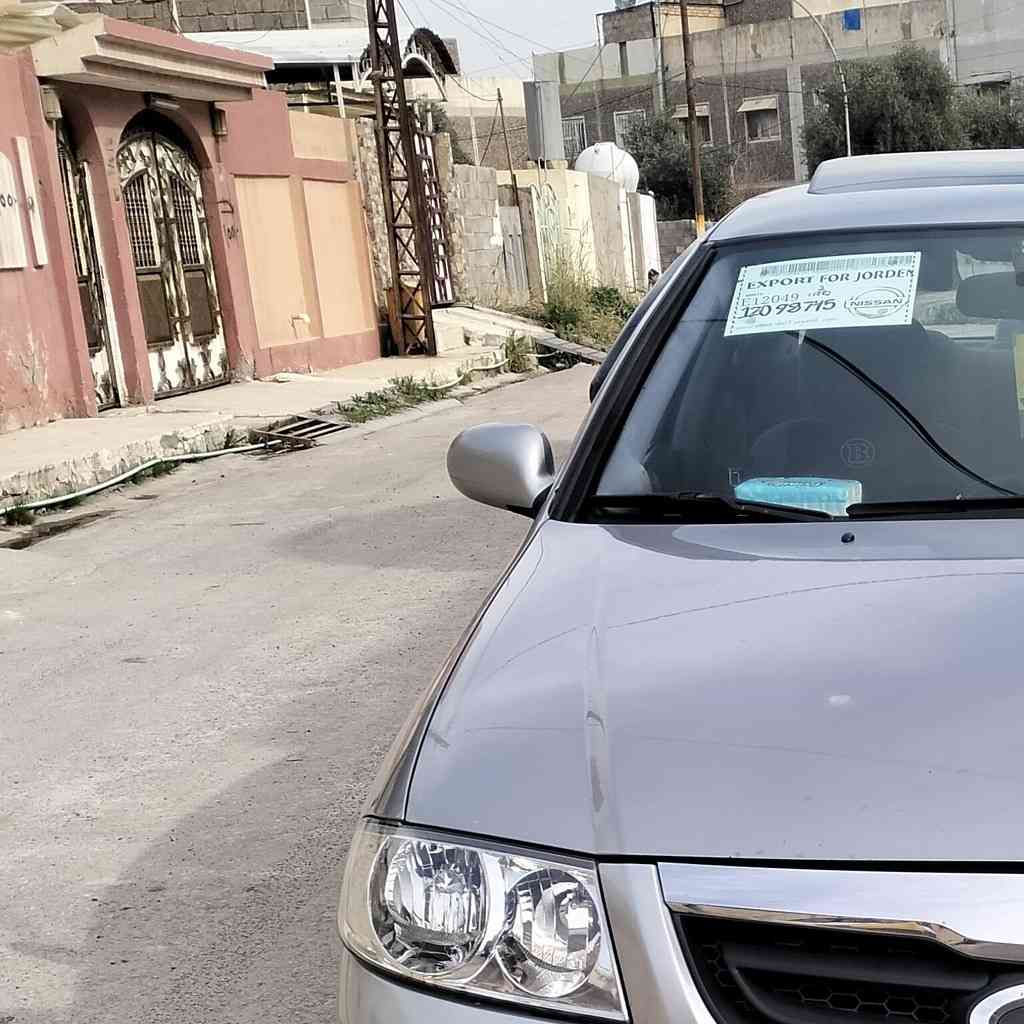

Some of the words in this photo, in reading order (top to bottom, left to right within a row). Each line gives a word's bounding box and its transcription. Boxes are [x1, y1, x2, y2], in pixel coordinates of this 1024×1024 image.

[747, 275, 812, 290] EXPORT
[820, 272, 849, 284] FOR
[855, 268, 914, 283] JORDEN
[850, 298, 904, 307] NISSAN
